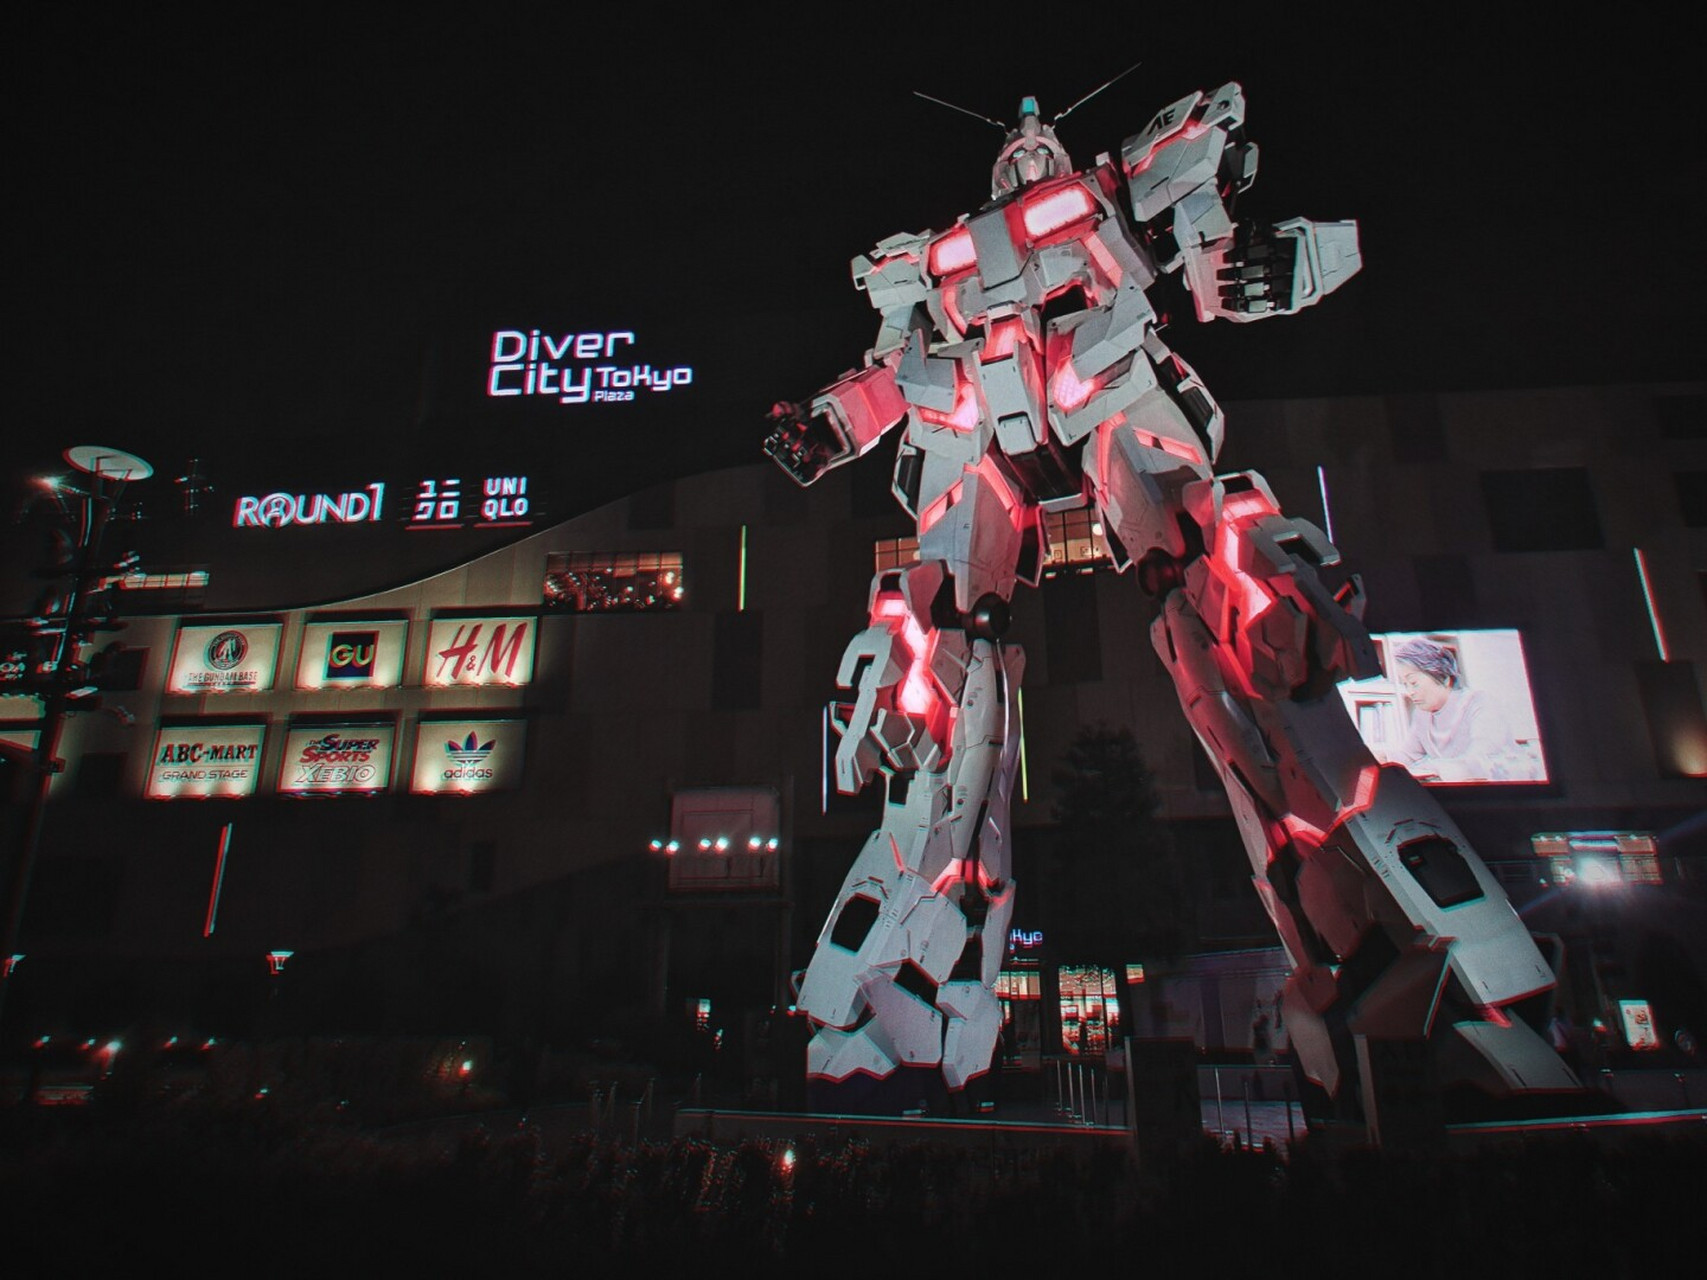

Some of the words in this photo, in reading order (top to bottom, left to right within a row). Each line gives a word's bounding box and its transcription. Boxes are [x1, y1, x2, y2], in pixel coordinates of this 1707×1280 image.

[490, 328, 636, 363] Diver
[487, 362, 592, 404] City
[594, 364, 693, 392] Tokyo
[592, 389, 635, 402] Plaza
[483, 476, 528, 497] UNI
[481, 497, 529, 521] QLO
[329, 643, 375, 669] GU
[436, 622, 528, 680] H&M
[188, 672, 204, 682] THE
[204, 671, 237, 682] GUNDAM
[238, 671, 259, 681] BASE
[320, 733, 380, 751] SUPER
[160, 743, 258, 763] ABC-MART
[300, 746, 371, 763] SPORTS
[163, 770, 206, 780] GRAND
[208, 769, 249, 779] STAGE
[294, 762, 377, 783] XEBIO
[443, 766, 494, 780] adidas
[1009, 928, 1043, 948] kyo
